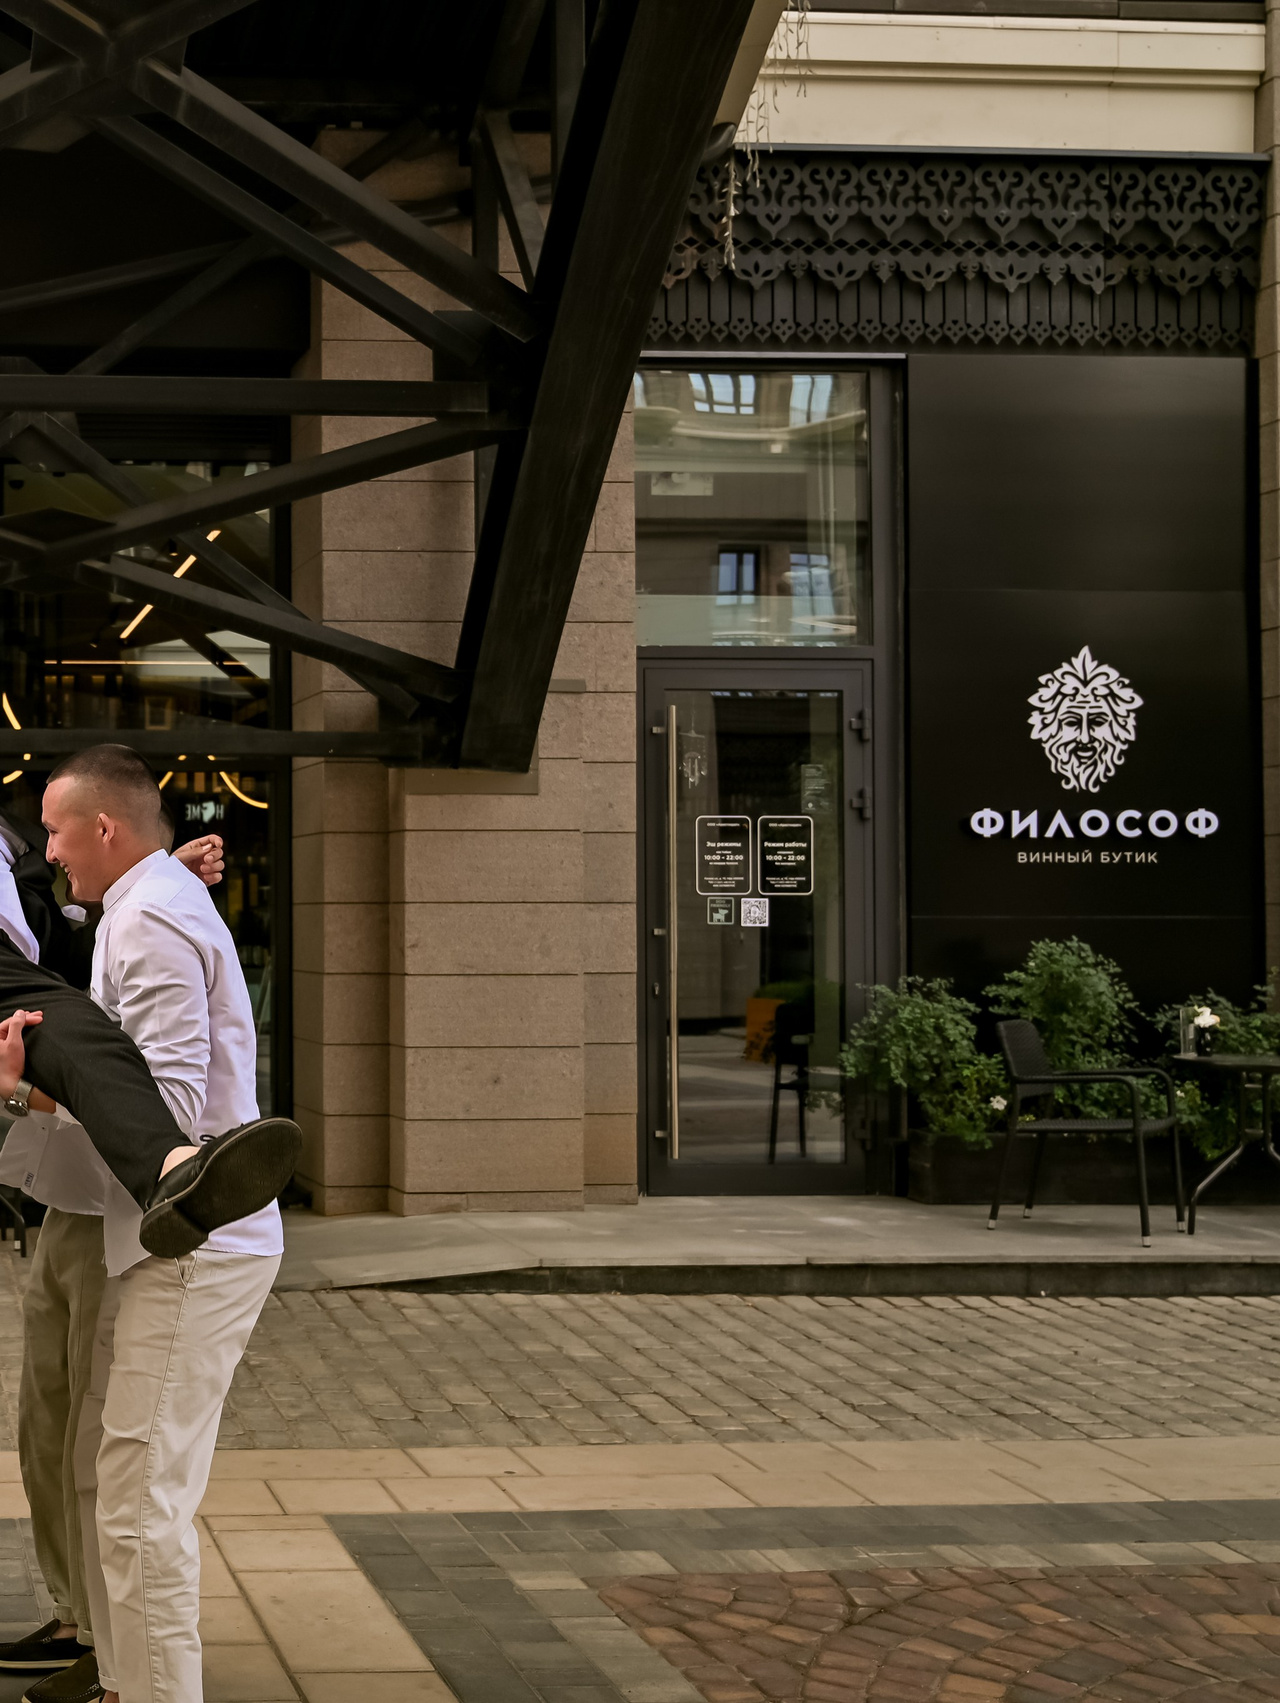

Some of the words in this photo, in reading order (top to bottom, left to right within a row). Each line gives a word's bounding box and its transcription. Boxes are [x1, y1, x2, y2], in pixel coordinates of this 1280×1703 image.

[970, 808, 1219, 838] ФИЛОСОФ
[1017, 850, 1093, 864] ВИННЫЙ
[1101, 851, 1158, 863] БУТИК
